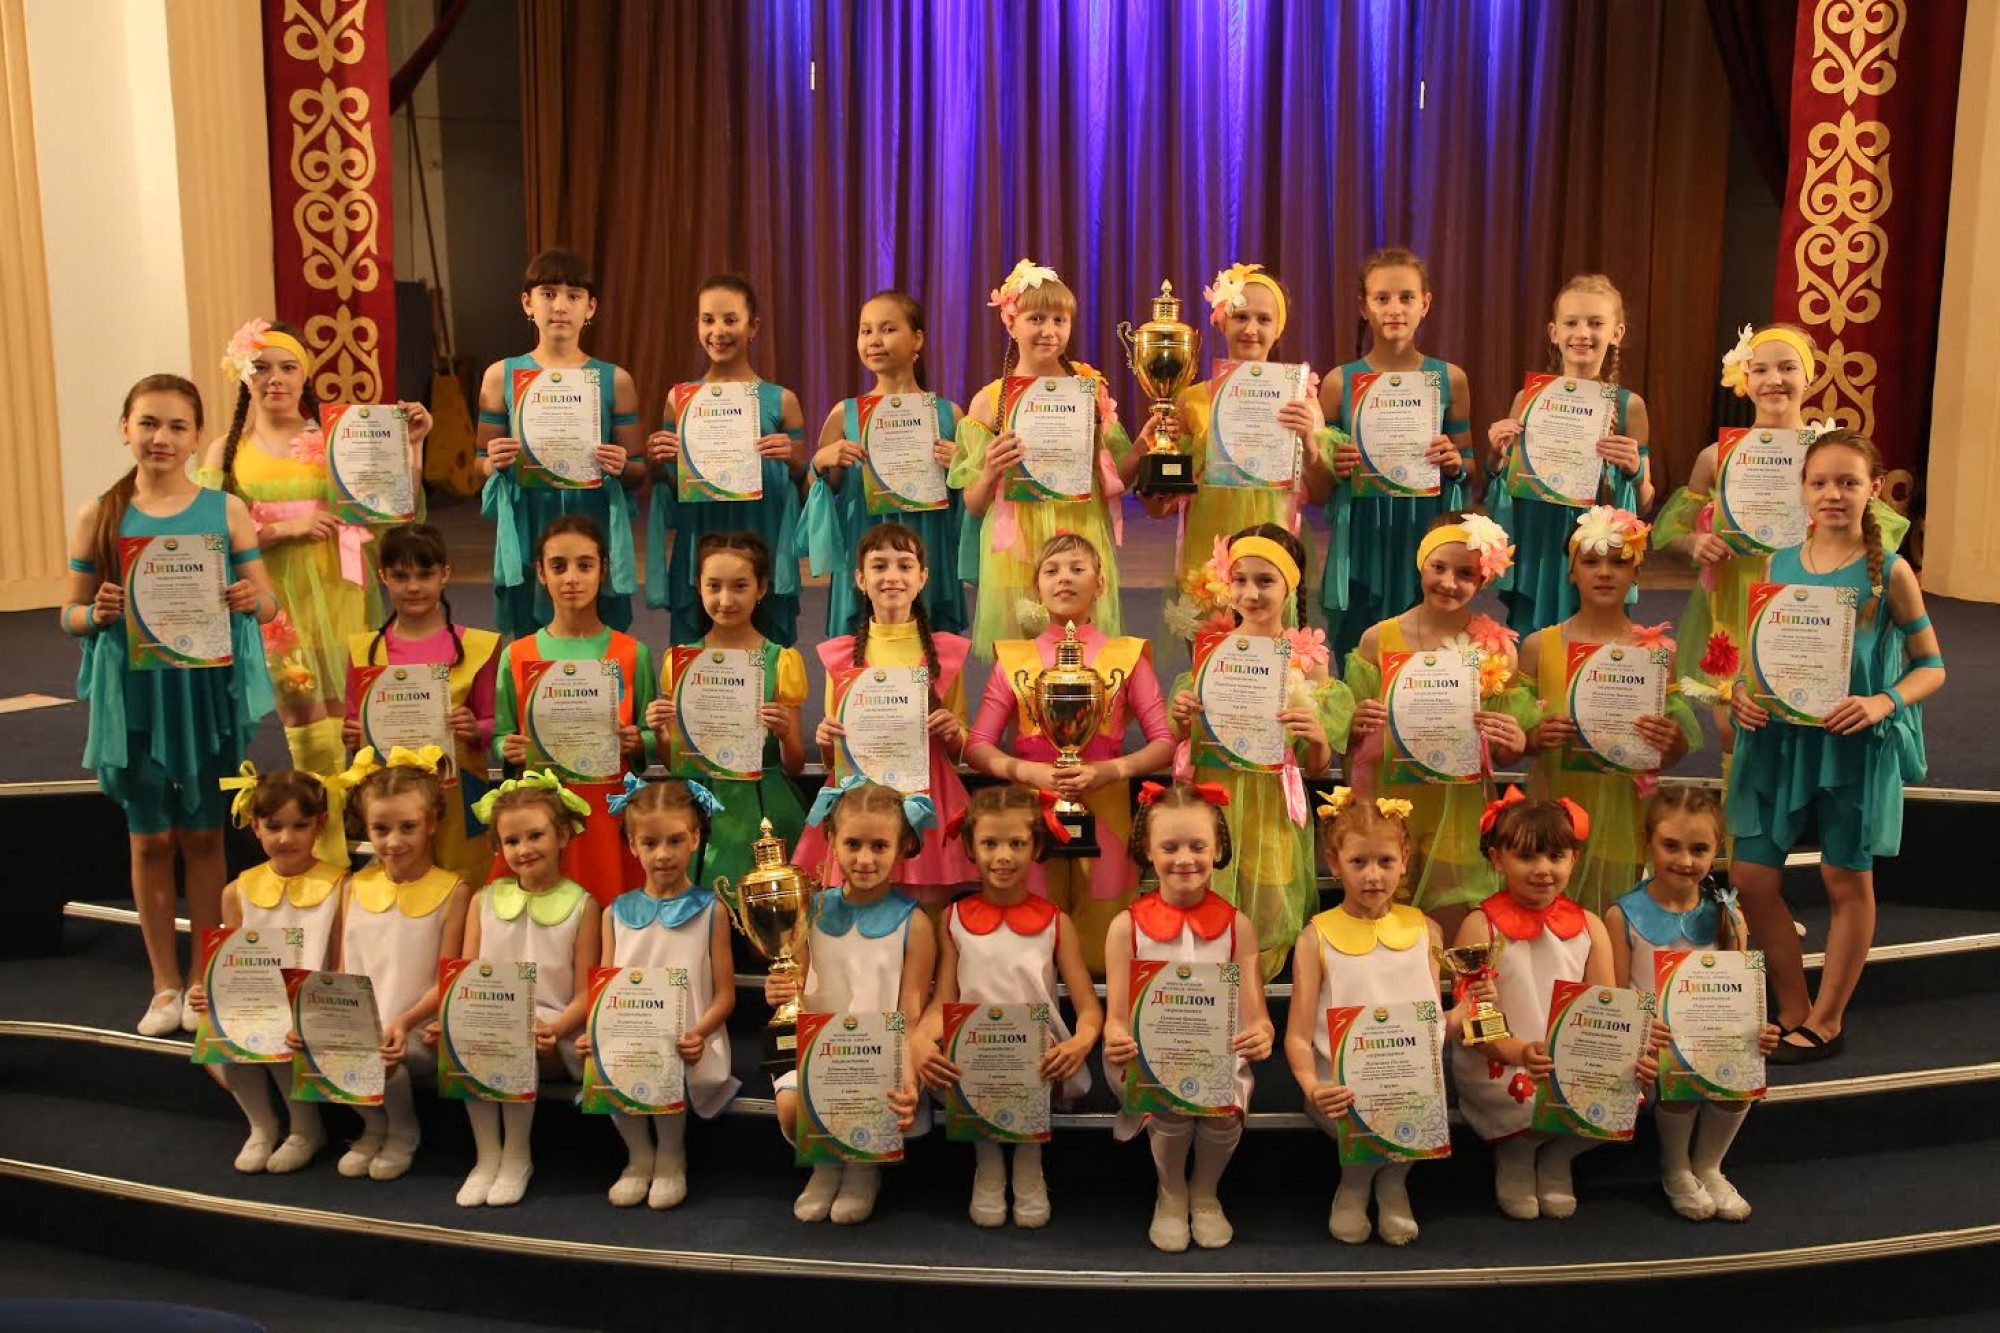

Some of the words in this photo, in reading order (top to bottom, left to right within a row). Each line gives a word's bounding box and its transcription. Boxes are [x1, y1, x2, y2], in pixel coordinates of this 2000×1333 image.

[532, 393, 582, 405] Диплом
[1229, 386, 1281, 399] Диплом
[1025, 401, 1076, 413] Диплом
[1370, 397, 1422, 409] Диплом
[1540, 399, 1593, 417] Диплом
[693, 406, 743, 418] Диплом
[876, 418, 922, 431] Диплом
[342, 428, 392, 441] Диплом
[1736, 453, 1793, 467] Диплом
[144, 562, 205, 575] Диплом
[1769, 612, 1831, 626] Диплом
[1214, 661, 1270, 676] Диплом
[691, 673, 745, 687] Диплом
[1403, 678, 1460, 690] Диплом
[1587, 669, 1645, 685] Диплом
[376, 691, 431, 703] Диплом
[543, 687, 599, 700] Диплом
[854, 694, 909, 706] Диплом
[223, 954, 282, 968] Диплом
[1678, 979, 1743, 994] Диплом
[458, 987, 515, 1002] Диплом
[1151, 991, 1216, 1007] Диплом
[607, 996, 665, 1010] Диплом
[1570, 1013, 1631, 1033] Диплом
[966, 1031, 1028, 1045] Диплом
[1354, 1036, 1417, 1052] Диплом
[820, 1043, 882, 1057] Диплом
